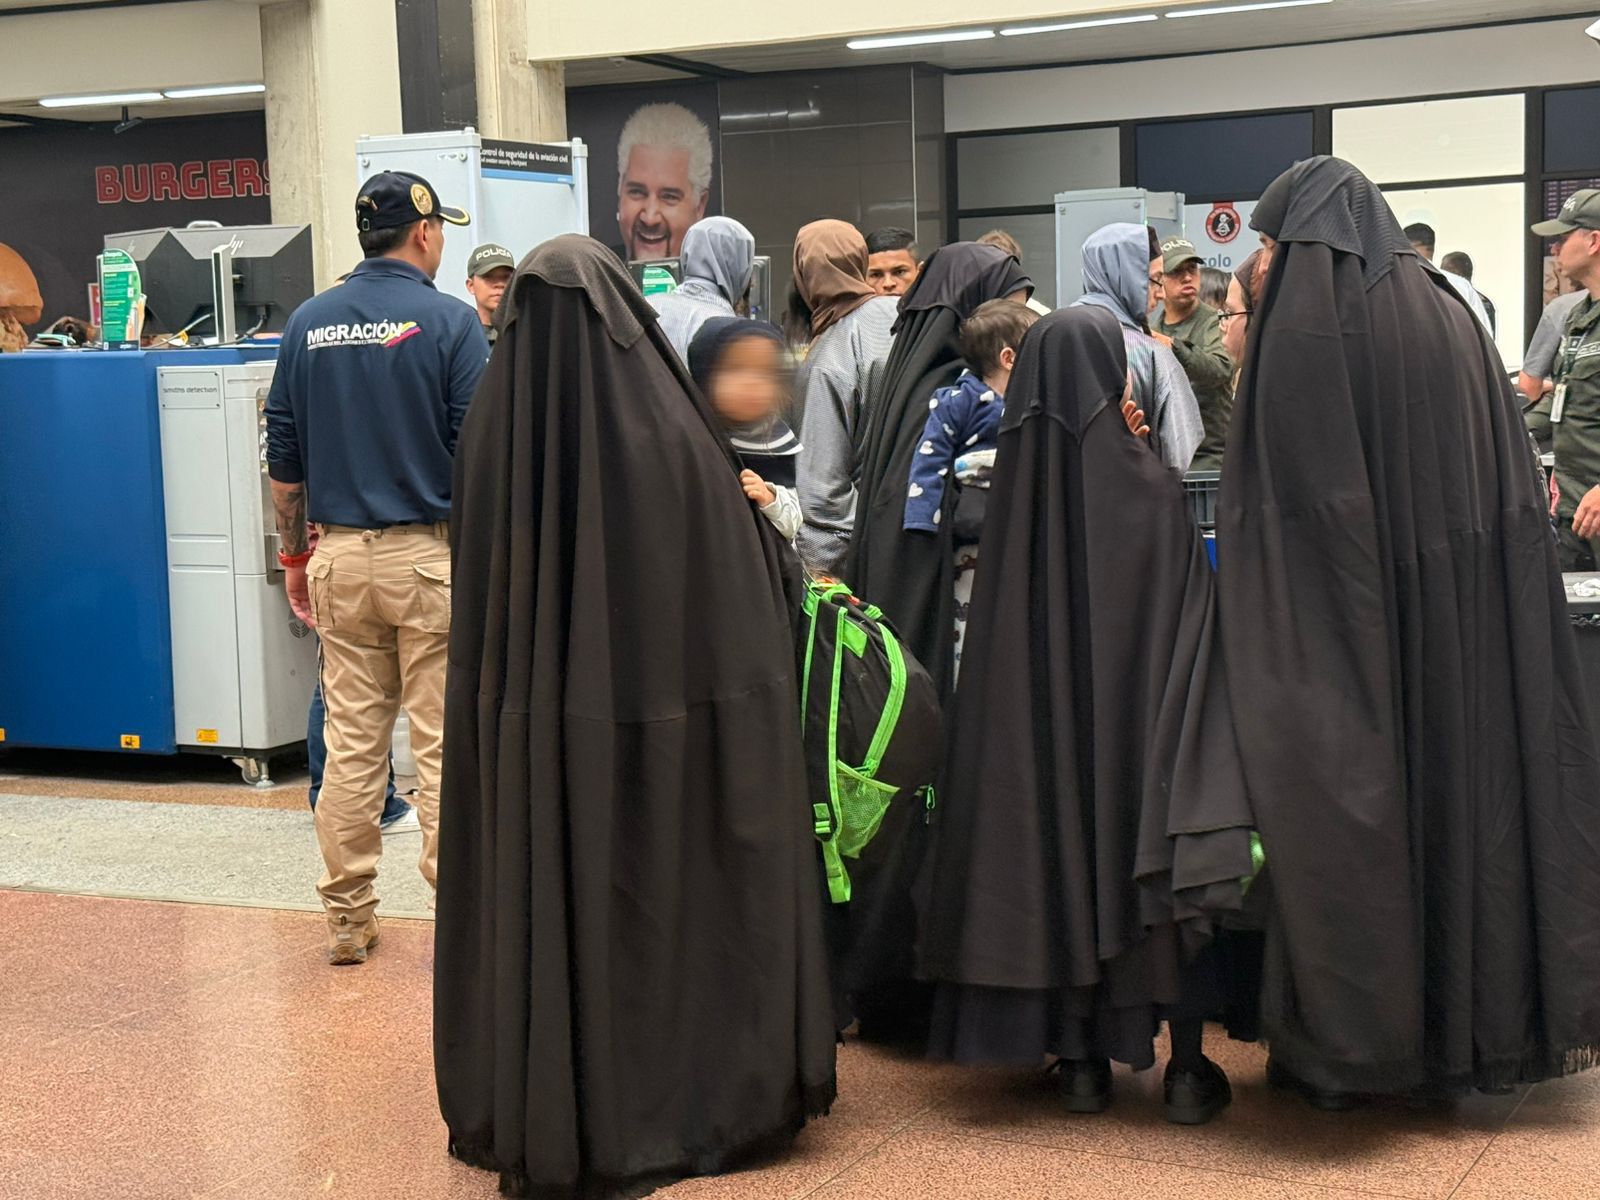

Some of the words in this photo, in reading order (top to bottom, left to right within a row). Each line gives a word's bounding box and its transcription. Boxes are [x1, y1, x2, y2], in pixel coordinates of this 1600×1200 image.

[498, 148, 505, 157] de
[95, 158, 271, 204] BURGER
[307, 318, 404, 346] MIGRACIÓN
